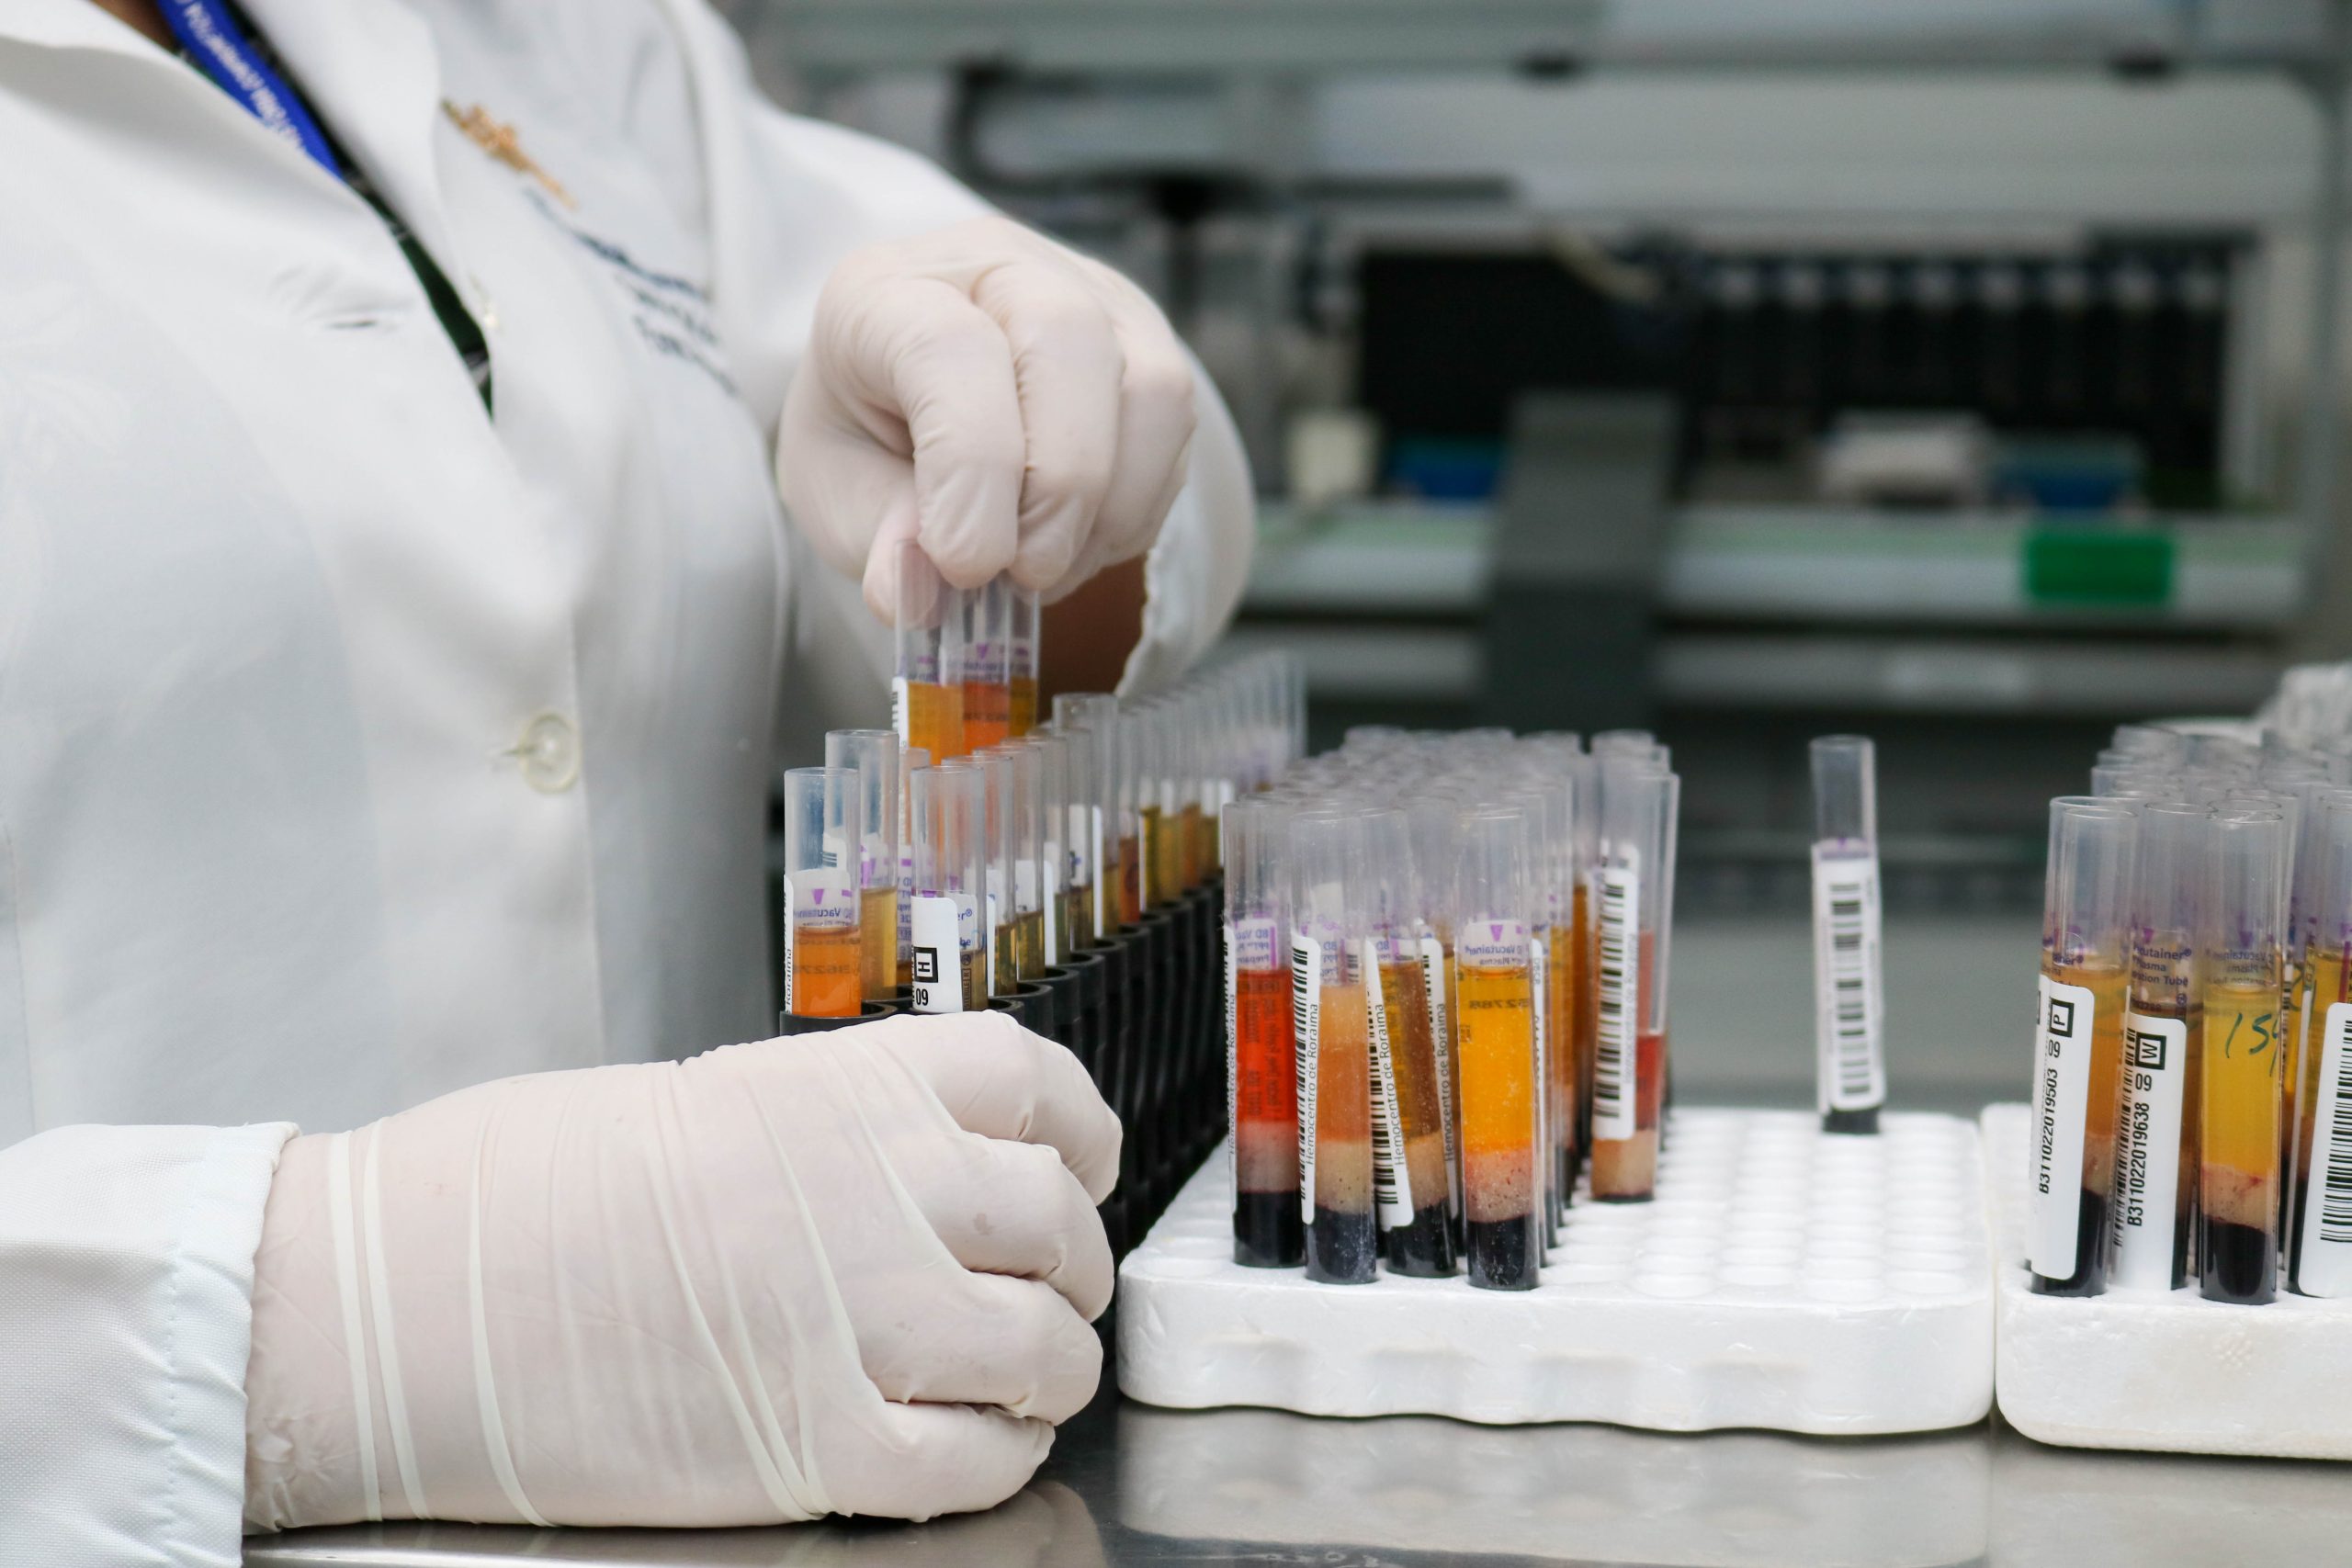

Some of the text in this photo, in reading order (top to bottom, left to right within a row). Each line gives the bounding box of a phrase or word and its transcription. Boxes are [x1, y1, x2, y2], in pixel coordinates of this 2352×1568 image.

[918, 962, 930, 973] H
[2163, 976, 2188, 987] Tube
[916, 988, 929, 1006] 09
[2053, 1014, 2065, 1026] P
[2048, 1039, 2061, 1058] 09
[2142, 1042, 2158, 1059] W
[1305, 1004, 1318, 1165] Hemocentro de Roraima
[1375, 1004, 1405, 1166] Hemocentro de Roraima
[1437, 1003, 1454, 1162] Hemocentro de Roraima
[2135, 1073, 2152, 1091] 09
[2039, 1068, 2058, 1194] B311022019503
[2127, 1102, 2150, 1227] B311022019638
